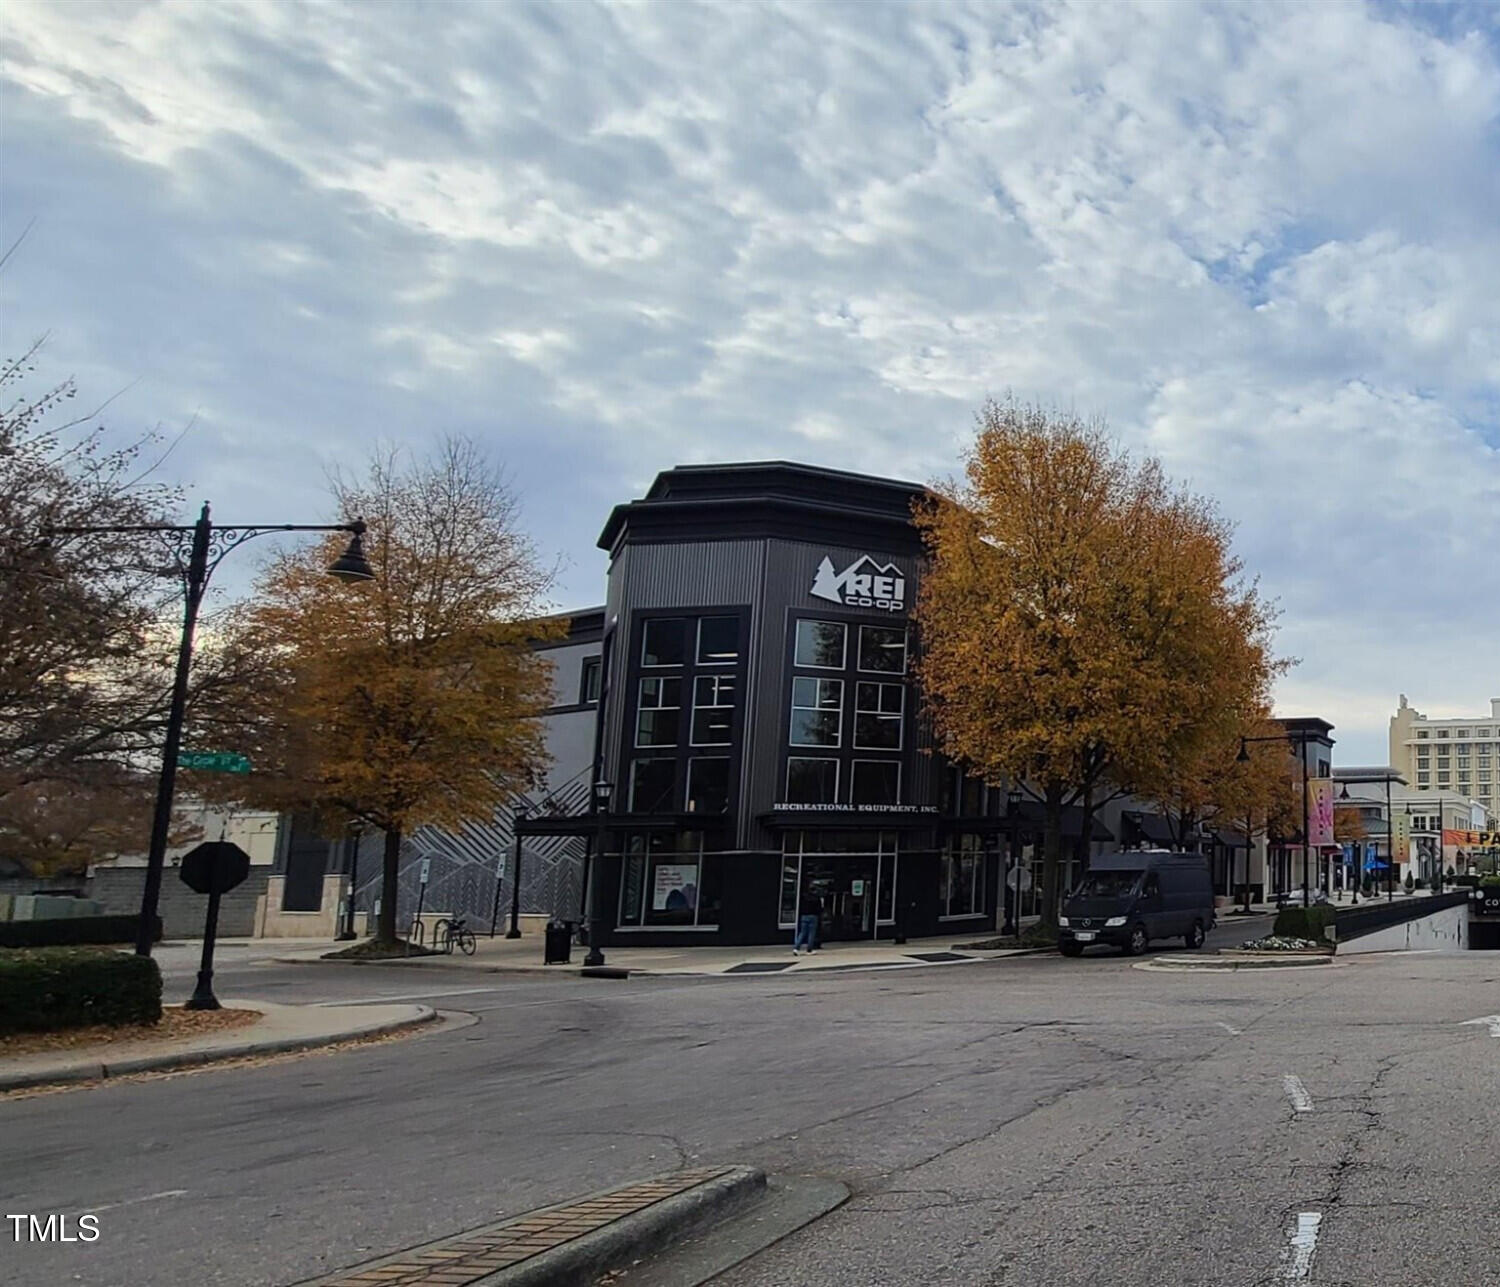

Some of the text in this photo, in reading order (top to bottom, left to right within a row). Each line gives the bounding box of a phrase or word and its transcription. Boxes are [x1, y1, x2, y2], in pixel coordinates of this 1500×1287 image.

[845, 573, 905, 601] REI
[774, 803, 856, 811] RECREATIONAL
[858, 804, 919, 813] EQUIPMENT,
